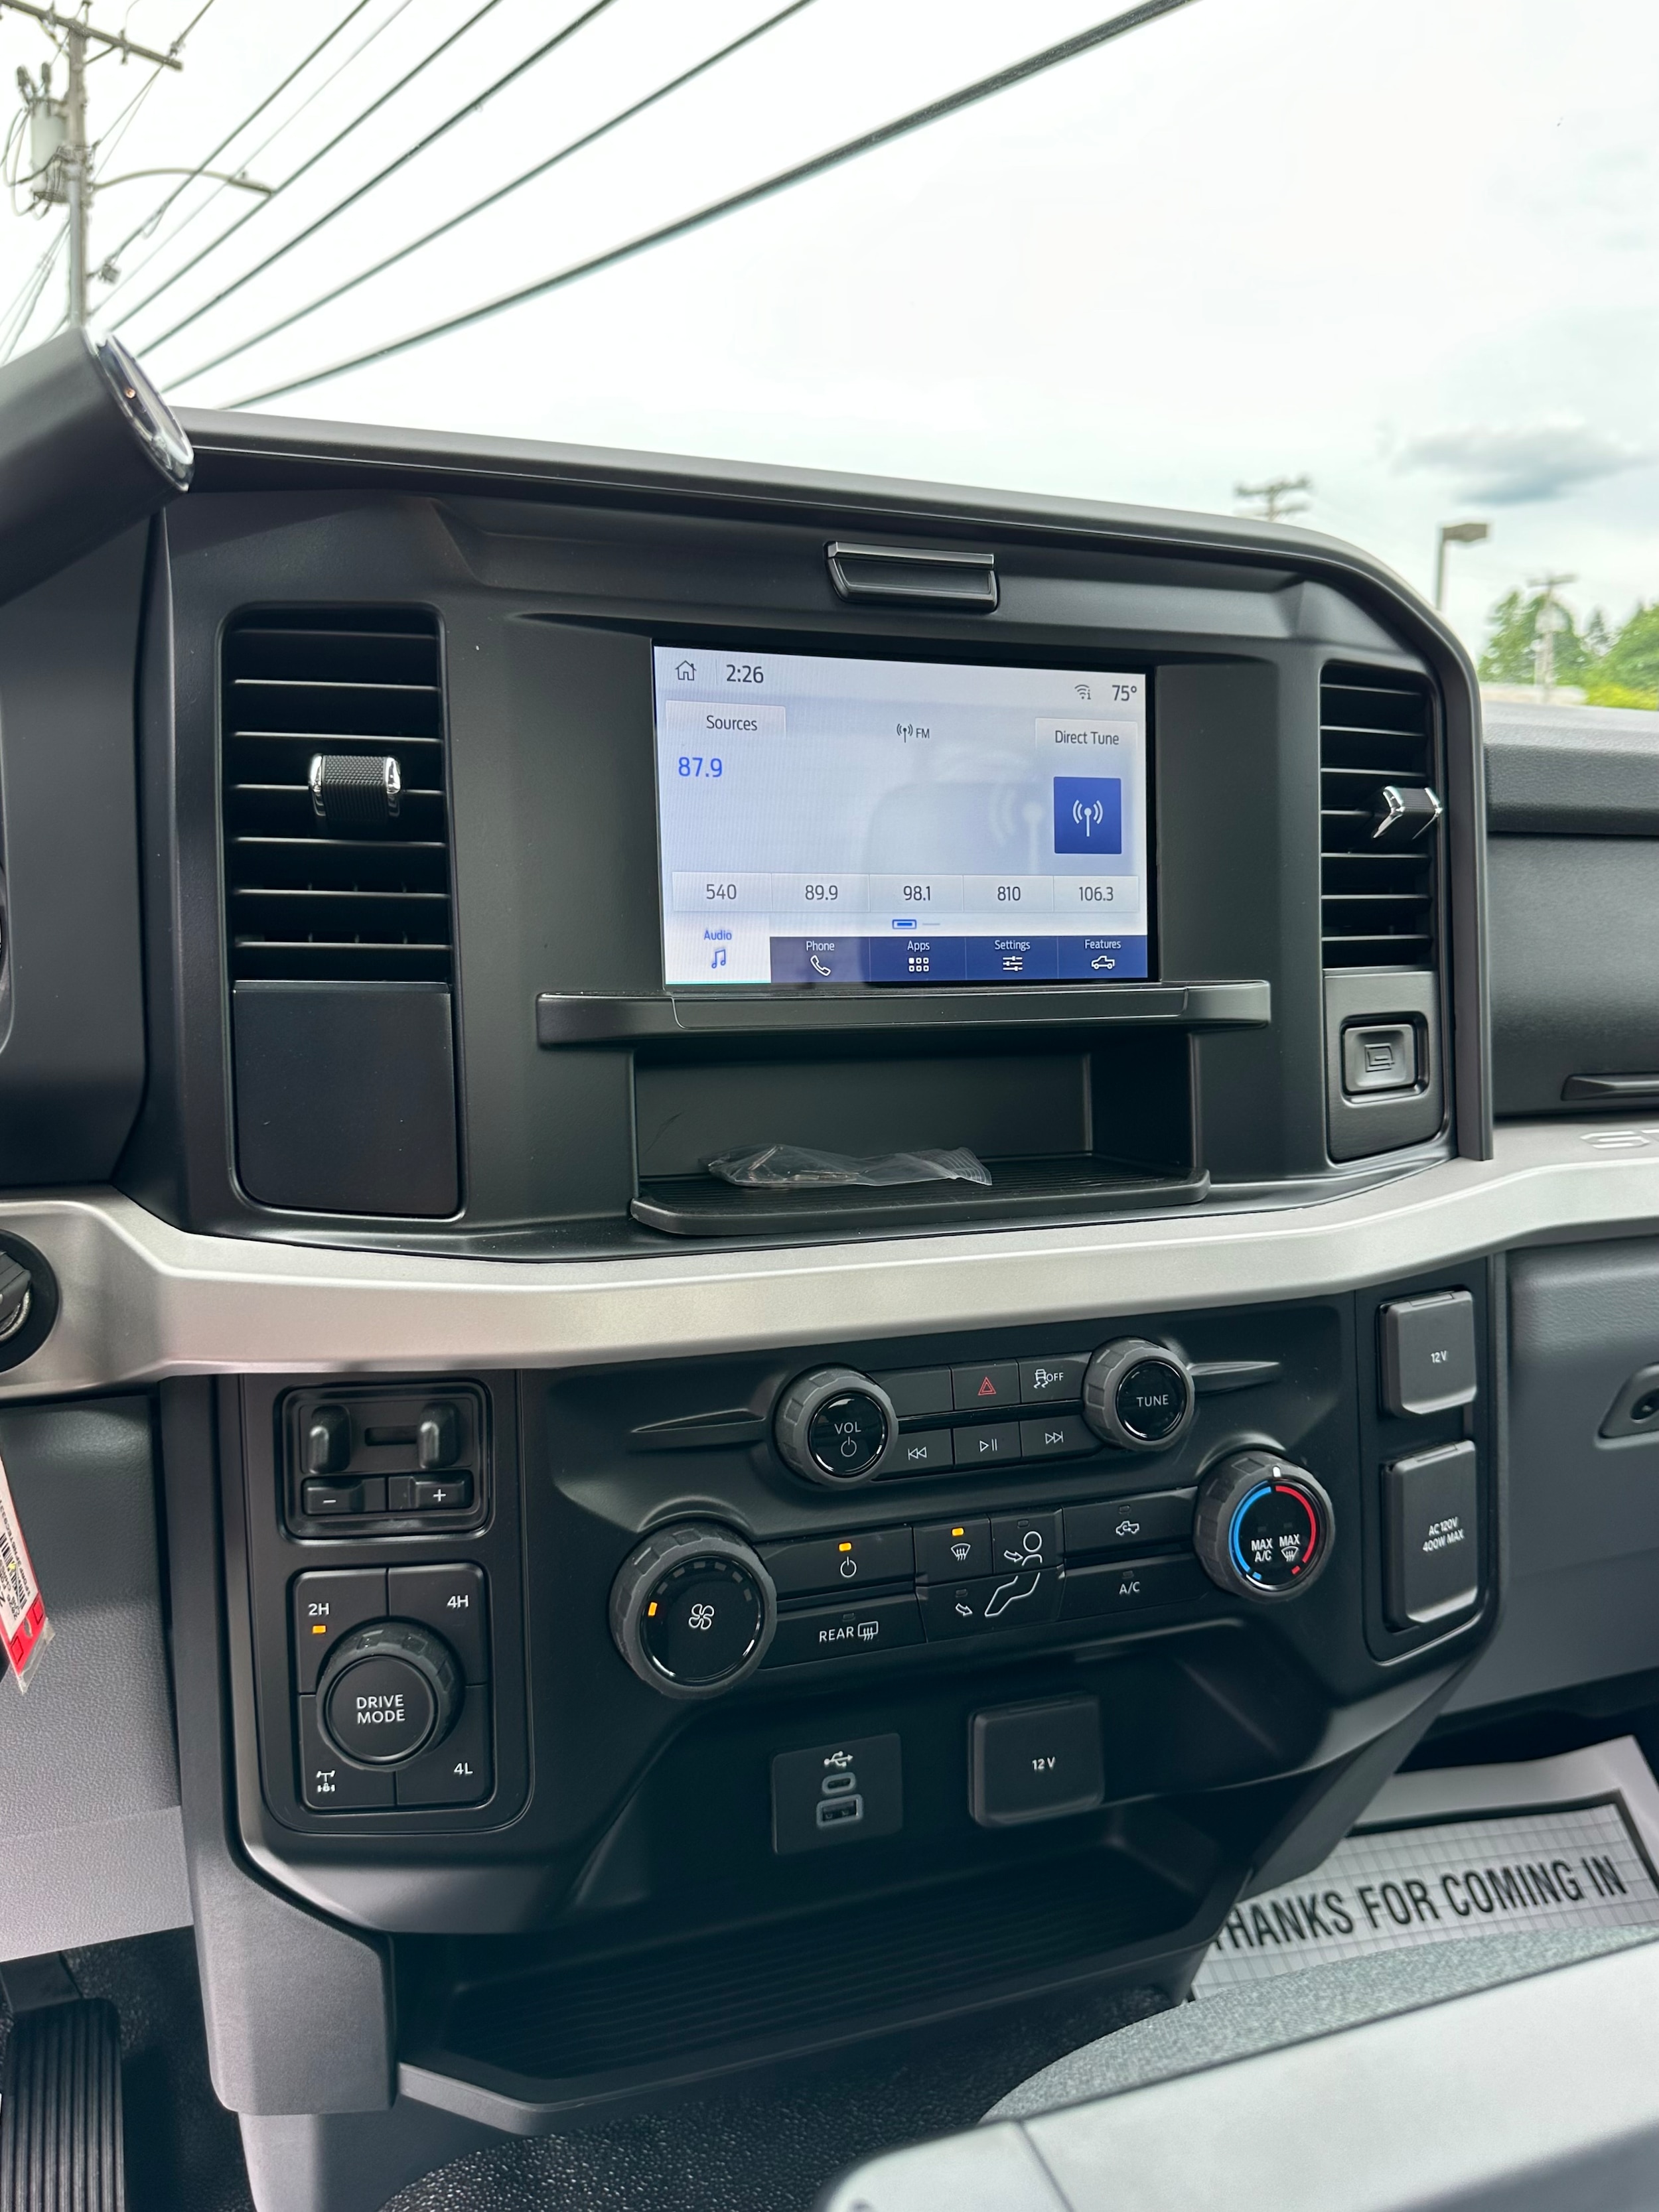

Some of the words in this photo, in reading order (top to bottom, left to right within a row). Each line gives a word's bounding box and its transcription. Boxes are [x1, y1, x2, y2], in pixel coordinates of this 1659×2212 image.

[726, 664, 764, 683] 2:26
[1112, 684, 1138, 702] 75°
[706, 715, 758, 732] Sources
[916, 728, 930, 739] FM
[1055, 730, 1088, 744] Direct
[1090, 731, 1119, 746] Tune
[678, 756, 723, 778] 87.9
[706, 884, 737, 900] 540
[805, 884, 839, 901] 89.9
[903, 885, 931, 902] 98.1
[997, 886, 1021, 902] 810
[1078, 886, 1114, 902] 106.3
[703, 930, 733, 941] Audio
[806, 940, 835, 952] Phone
[907, 940, 930, 953] Apps
[994, 939, 1031, 953] Settings
[1084, 939, 1122, 950] Features
[1046, 1371, 1064, 1383] OFF
[1136, 1394, 1169, 1407] TUNE
[834, 1422, 862, 1434] VOL
[1428, 1523, 1440, 1537] AC
[1440, 1517, 1459, 1532] 120V
[1251, 1538, 1273, 1551] MAX
[1279, 1533, 1301, 1547] MAX
[1422, 1535, 1447, 1552] 400W
[1447, 1529, 1465, 1544] MAX
[1254, 1549, 1272, 1562] A/C
[1119, 1581, 1141, 1595] A/C
[447, 1594, 469, 1608] 4H
[308, 1602, 330, 1616] 2H
[819, 1626, 855, 1642] REAR
[356, 1694, 404, 1710] DRIVE
[356, 1708, 405, 1724] MODE
[453, 1762, 473, 1775] 4L
[1216, 1890, 1354, 1951] HANKS
[1357, 1877, 1441, 1929] FOR
[1439, 1859, 1583, 1917] COMING
[1581, 1854, 1628, 1898] IN
